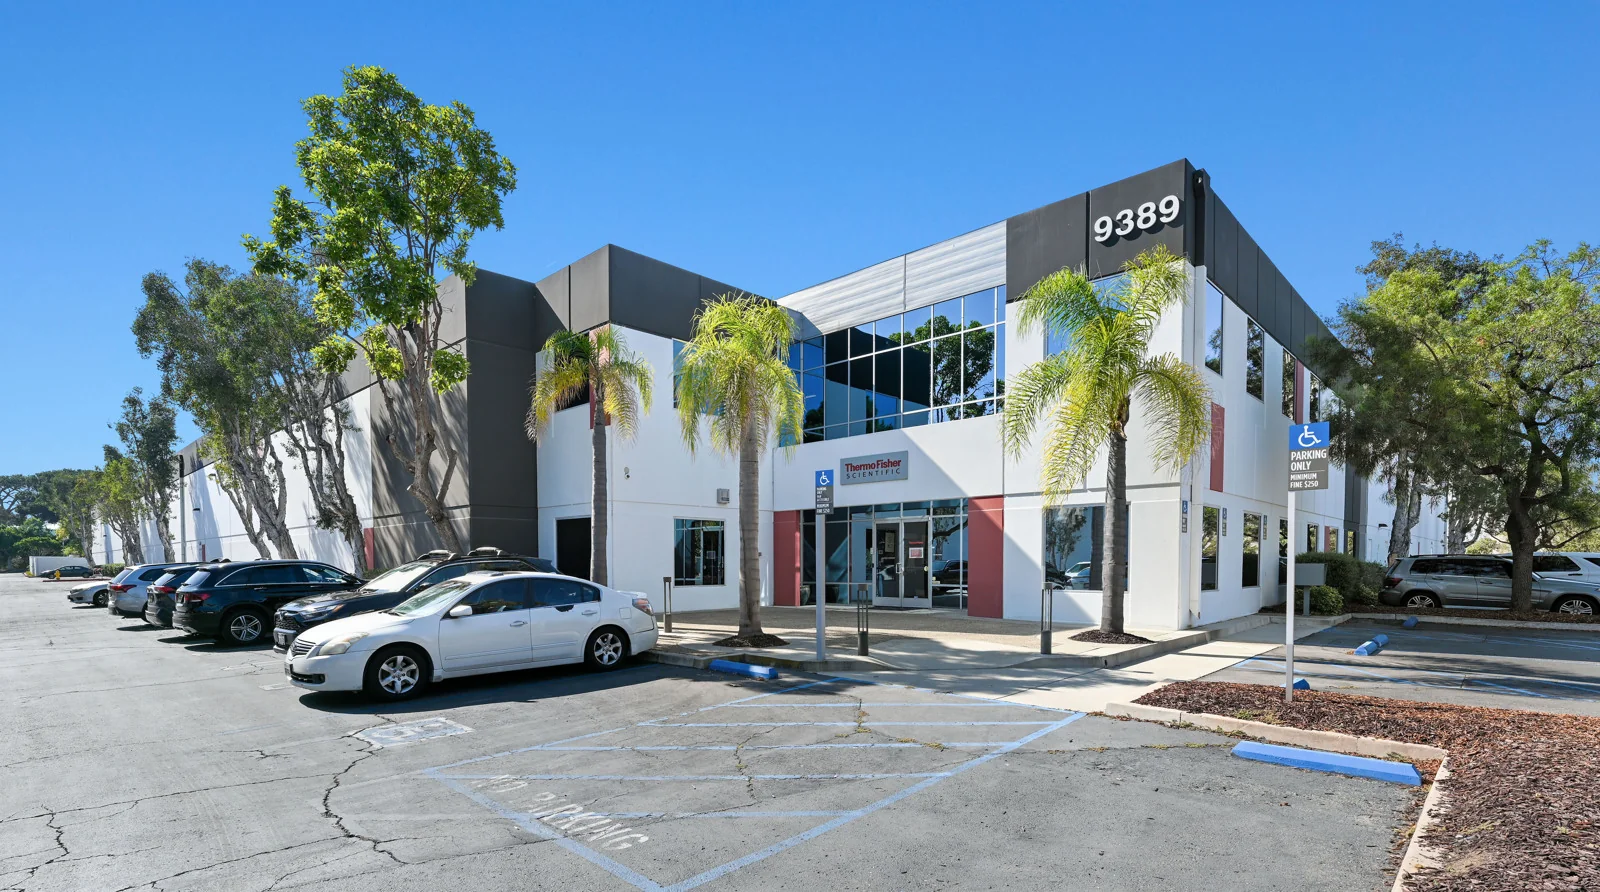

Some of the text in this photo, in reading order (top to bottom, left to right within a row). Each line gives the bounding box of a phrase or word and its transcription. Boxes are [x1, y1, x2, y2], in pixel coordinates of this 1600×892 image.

[1094, 194, 1180, 243] 9389
[1290, 449, 1327, 461] PARKING
[1290, 460, 1312, 471] ONLY
[846, 467, 901, 480] SCIENTIFIC
[1290, 472, 1317, 481] MINIMUM
[1290, 480, 1319, 489] FINE $250
